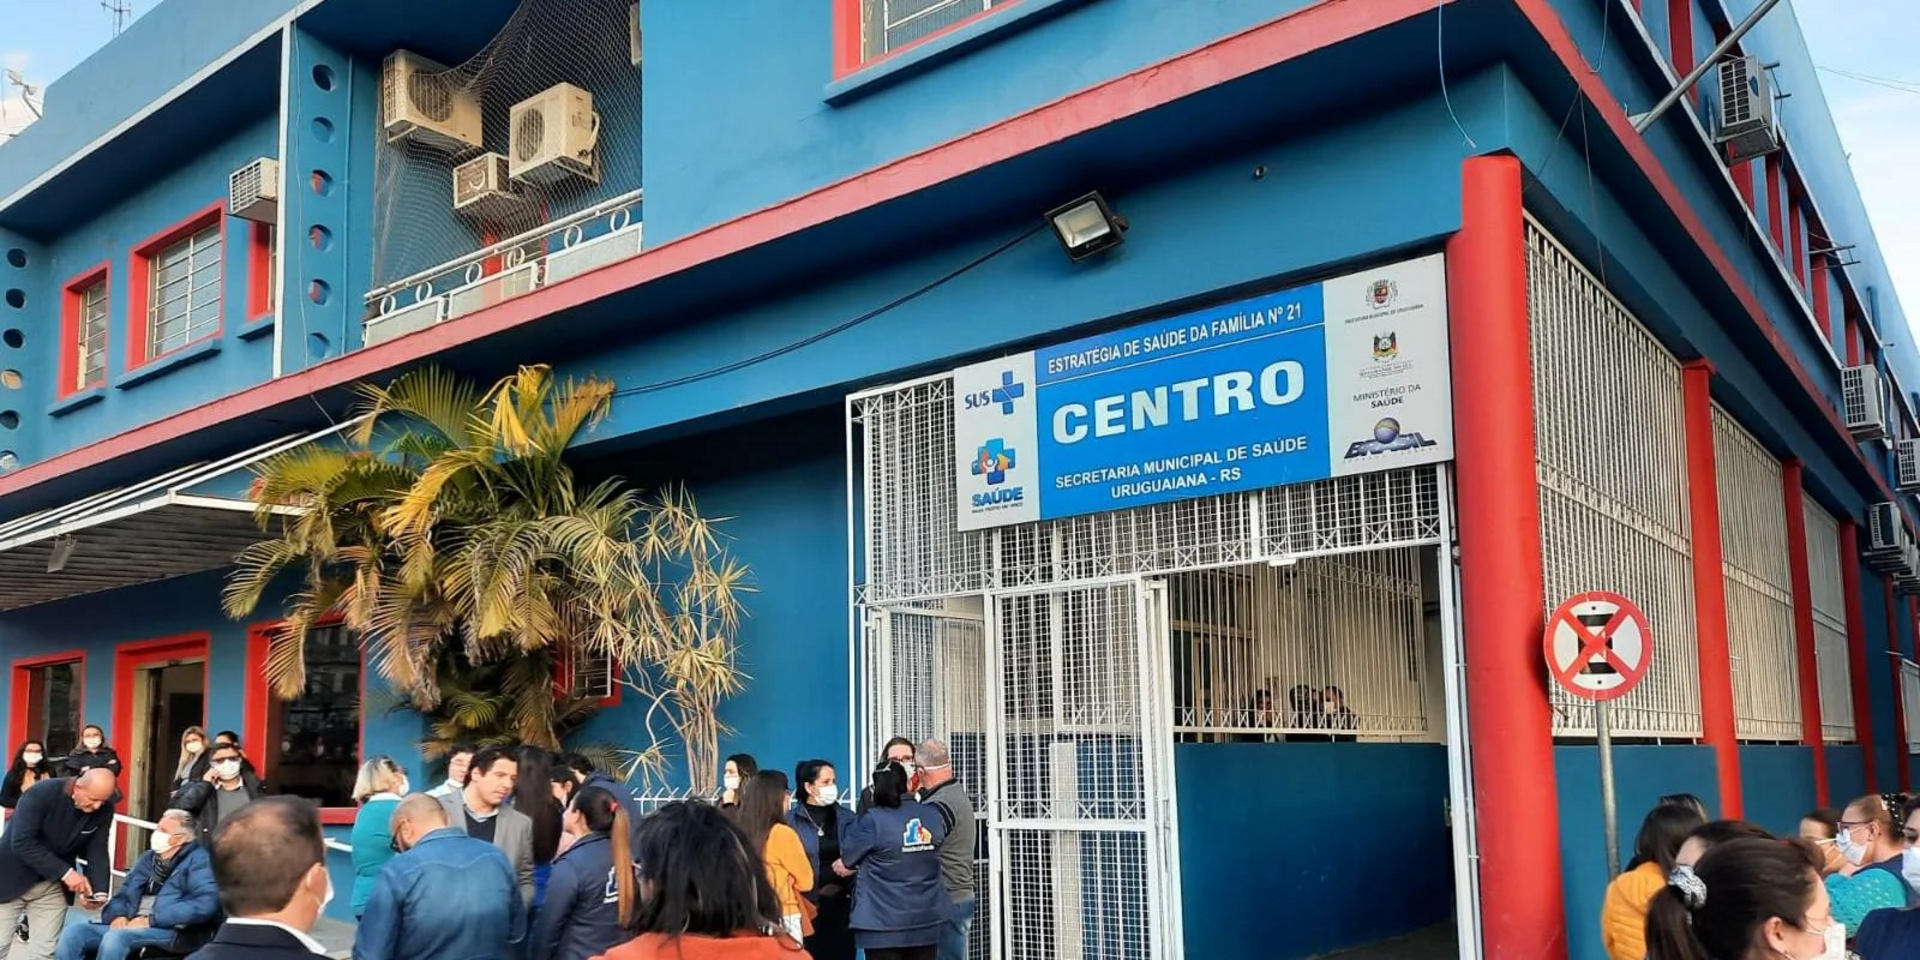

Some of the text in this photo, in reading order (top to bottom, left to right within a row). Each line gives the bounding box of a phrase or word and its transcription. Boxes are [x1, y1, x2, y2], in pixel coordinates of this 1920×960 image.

[1048, 346, 1121, 374] ESTRATÉGIA
[1124, 340, 1141, 356] DE
[1144, 328, 1189, 353] SAÚDE
[1190, 325, 1209, 341] DA
[1211, 311, 1265, 338] FAMÍLIA
[1287, 302, 1302, 321] 21
[964, 390, 991, 410] SUS
[1052, 360, 1305, 445] CENTRO
[1352, 383, 1421, 402] MINISTÉRIO DA
[1370, 395, 1404, 409] SAÚDE
[1055, 436, 1308, 489] SECRETARIA MUNICIPAL DE SAÚDE
[1111, 474, 1207, 499] URUGUAIANA
[1221, 467, 1242, 481] RS
[971, 486, 1024, 507] SAÚDE
